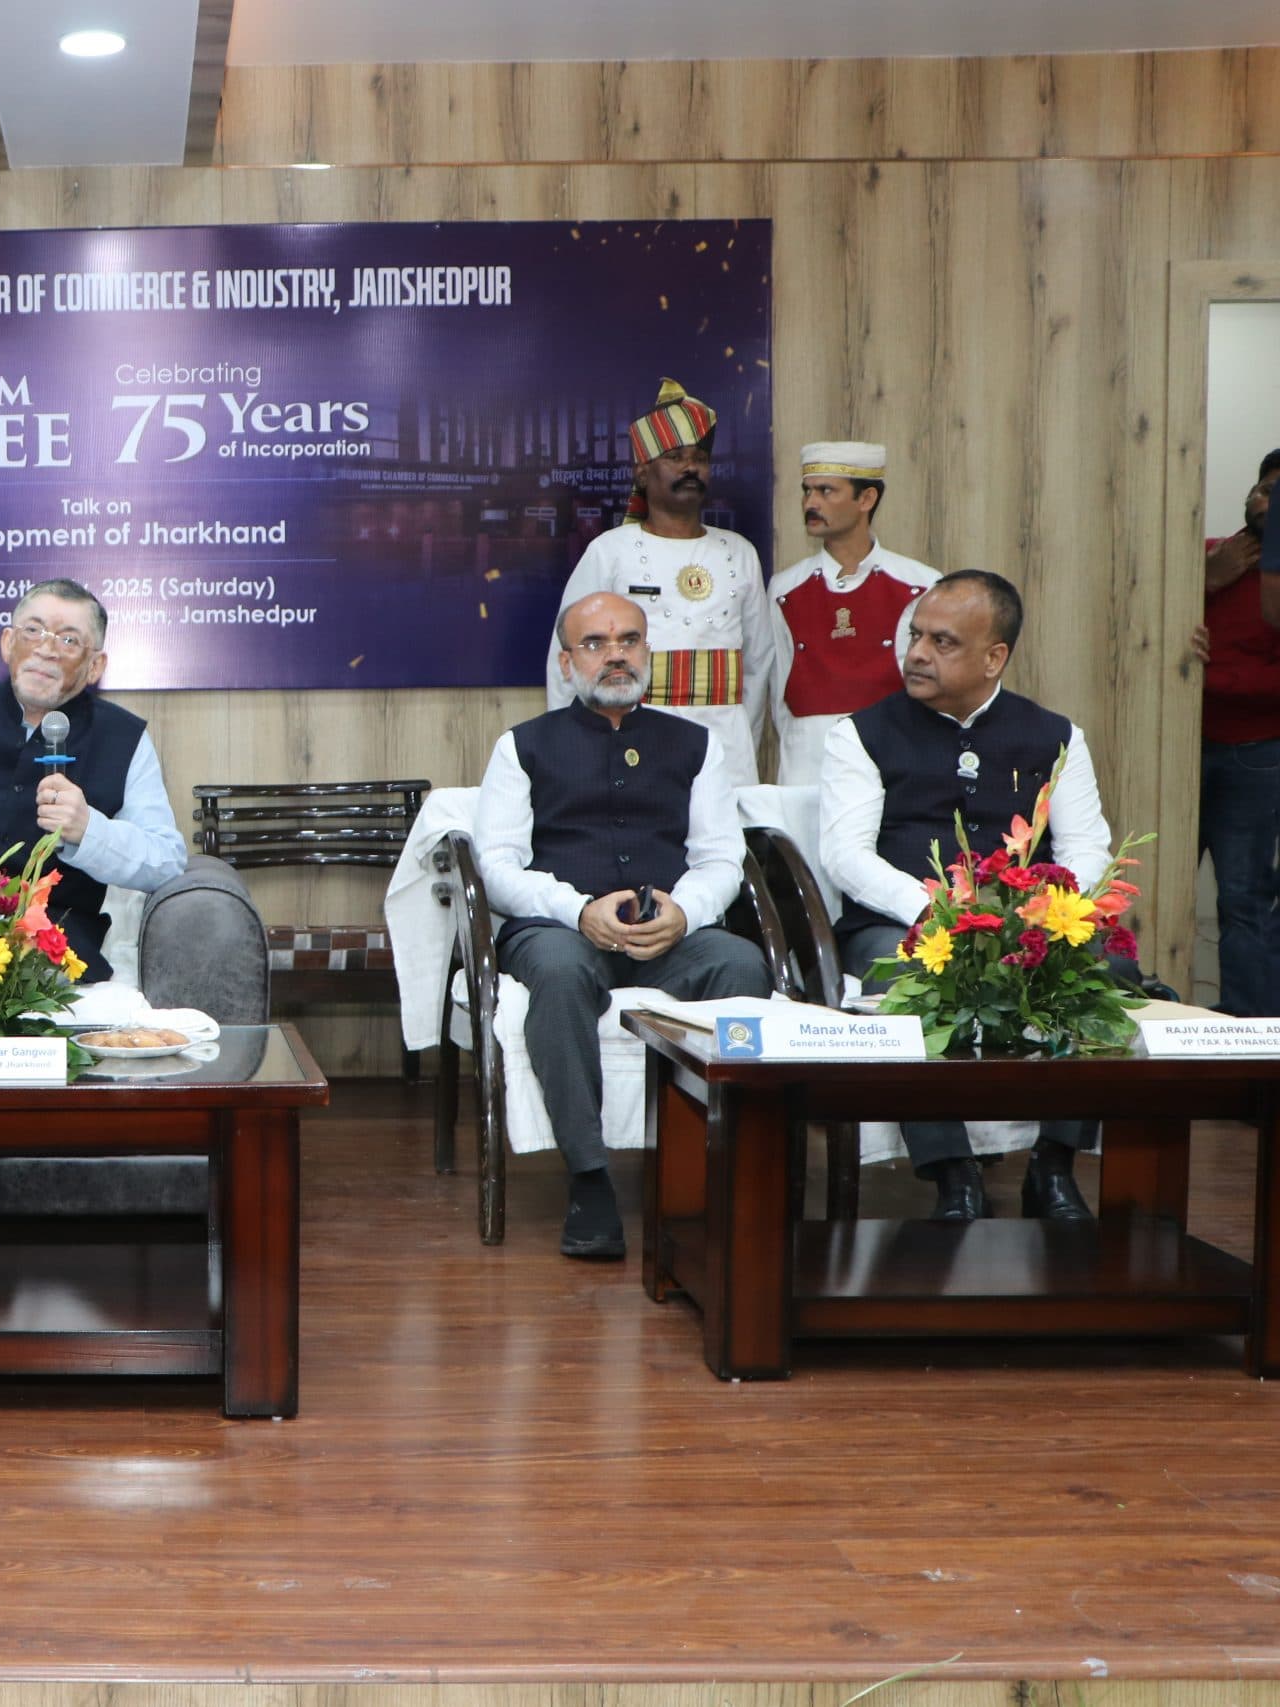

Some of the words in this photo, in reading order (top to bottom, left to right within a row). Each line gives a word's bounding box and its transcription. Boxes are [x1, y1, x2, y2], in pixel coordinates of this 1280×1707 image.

[16, 273, 46, 313] OF
[53, 270, 187, 313] COMMERCE
[192, 270, 211, 309] &
[216, 268, 341, 314] INDUSTRY,
[348, 266, 513, 307] JAMSHEDPUR
[115, 363, 262, 387] Celebrating
[111, 394, 207, 464] 75
[218, 392, 370, 433] Years
[218, 441, 238, 458] of
[242, 440, 372, 461] Incorporation
[60, 498, 101, 516] Talk
[106, 501, 132, 515] on
[104, 523, 132, 546] of
[139, 520, 287, 545] Jharkhand
[101, 578, 153, 597] 2025
[159, 576, 276, 601] (Saturday)
[179, 604, 318, 628] Jamshedpur
[799, 1023, 844, 1035] Manav
[848, 1023, 888, 1035] Kedia
[1165, 1026, 1199, 1034] RAJIV
[11, 1047, 57, 1059] Gangwar
[789, 1039, 826, 1048] General
[828, 1039, 877, 1050] Secretary,
[879, 1039, 901, 1048] SCCI
